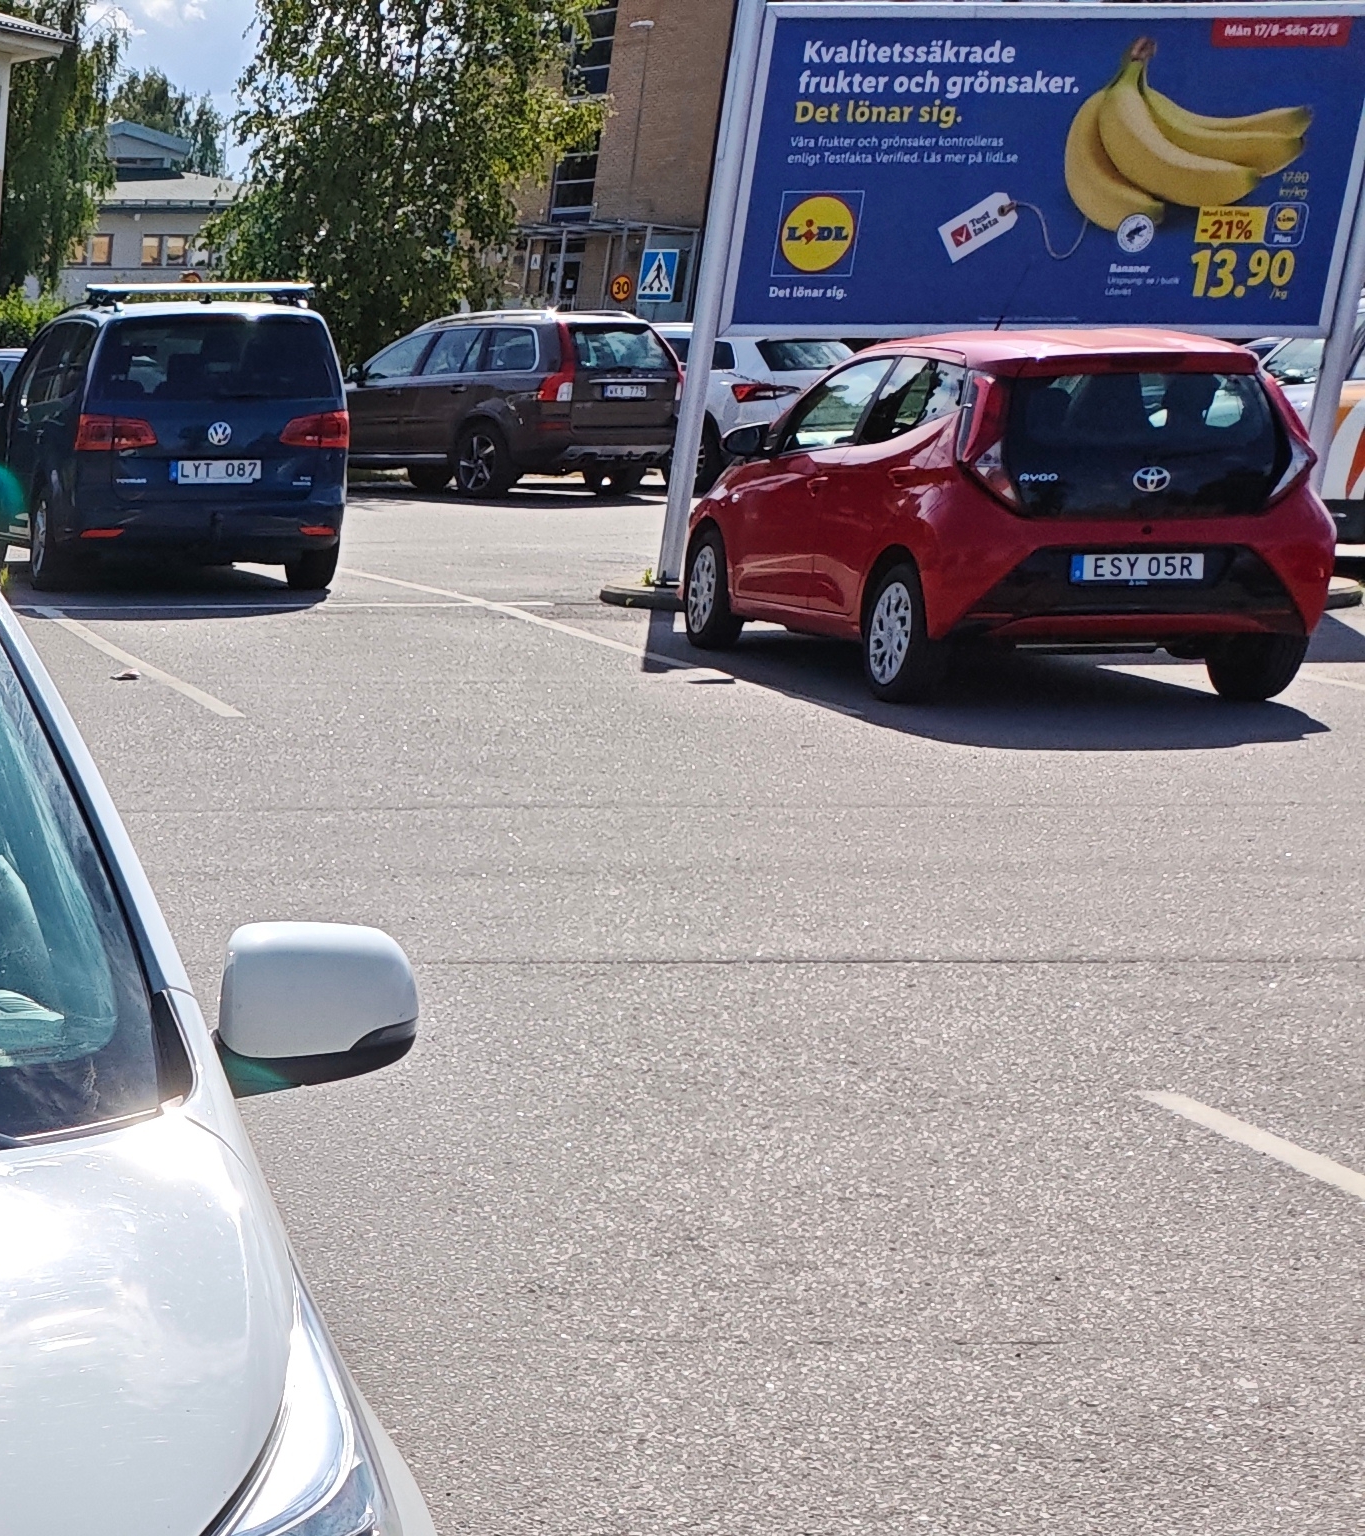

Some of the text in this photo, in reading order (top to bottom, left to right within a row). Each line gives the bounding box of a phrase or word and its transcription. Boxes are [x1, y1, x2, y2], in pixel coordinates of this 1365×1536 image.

[803, 39, 1016, 64] Kvalitetssäkrade
[798, 70, 1080, 99] frukter och grönsaker.
[794, 100, 963, 128] Det lönar sig.
[790, 135, 1004, 151] Våra frukter och grönsaker kontrolleras
[787, 152, 820, 167] enligt
[823, 152, 872, 164] Testfakta
[923, 152, 942, 164] Läs
[945, 154, 966, 164] mer
[968, 151, 982, 166] på
[1200, 219, 1253, 240] -21%
[1190, 249, 1296, 298] 13.90
[614, 282, 630, 295] 30
[769, 285, 847, 301] Det lönar sig.
[180, 462, 257, 478] LYT 087
[1094, 556, 1193, 577] ESY 05R
